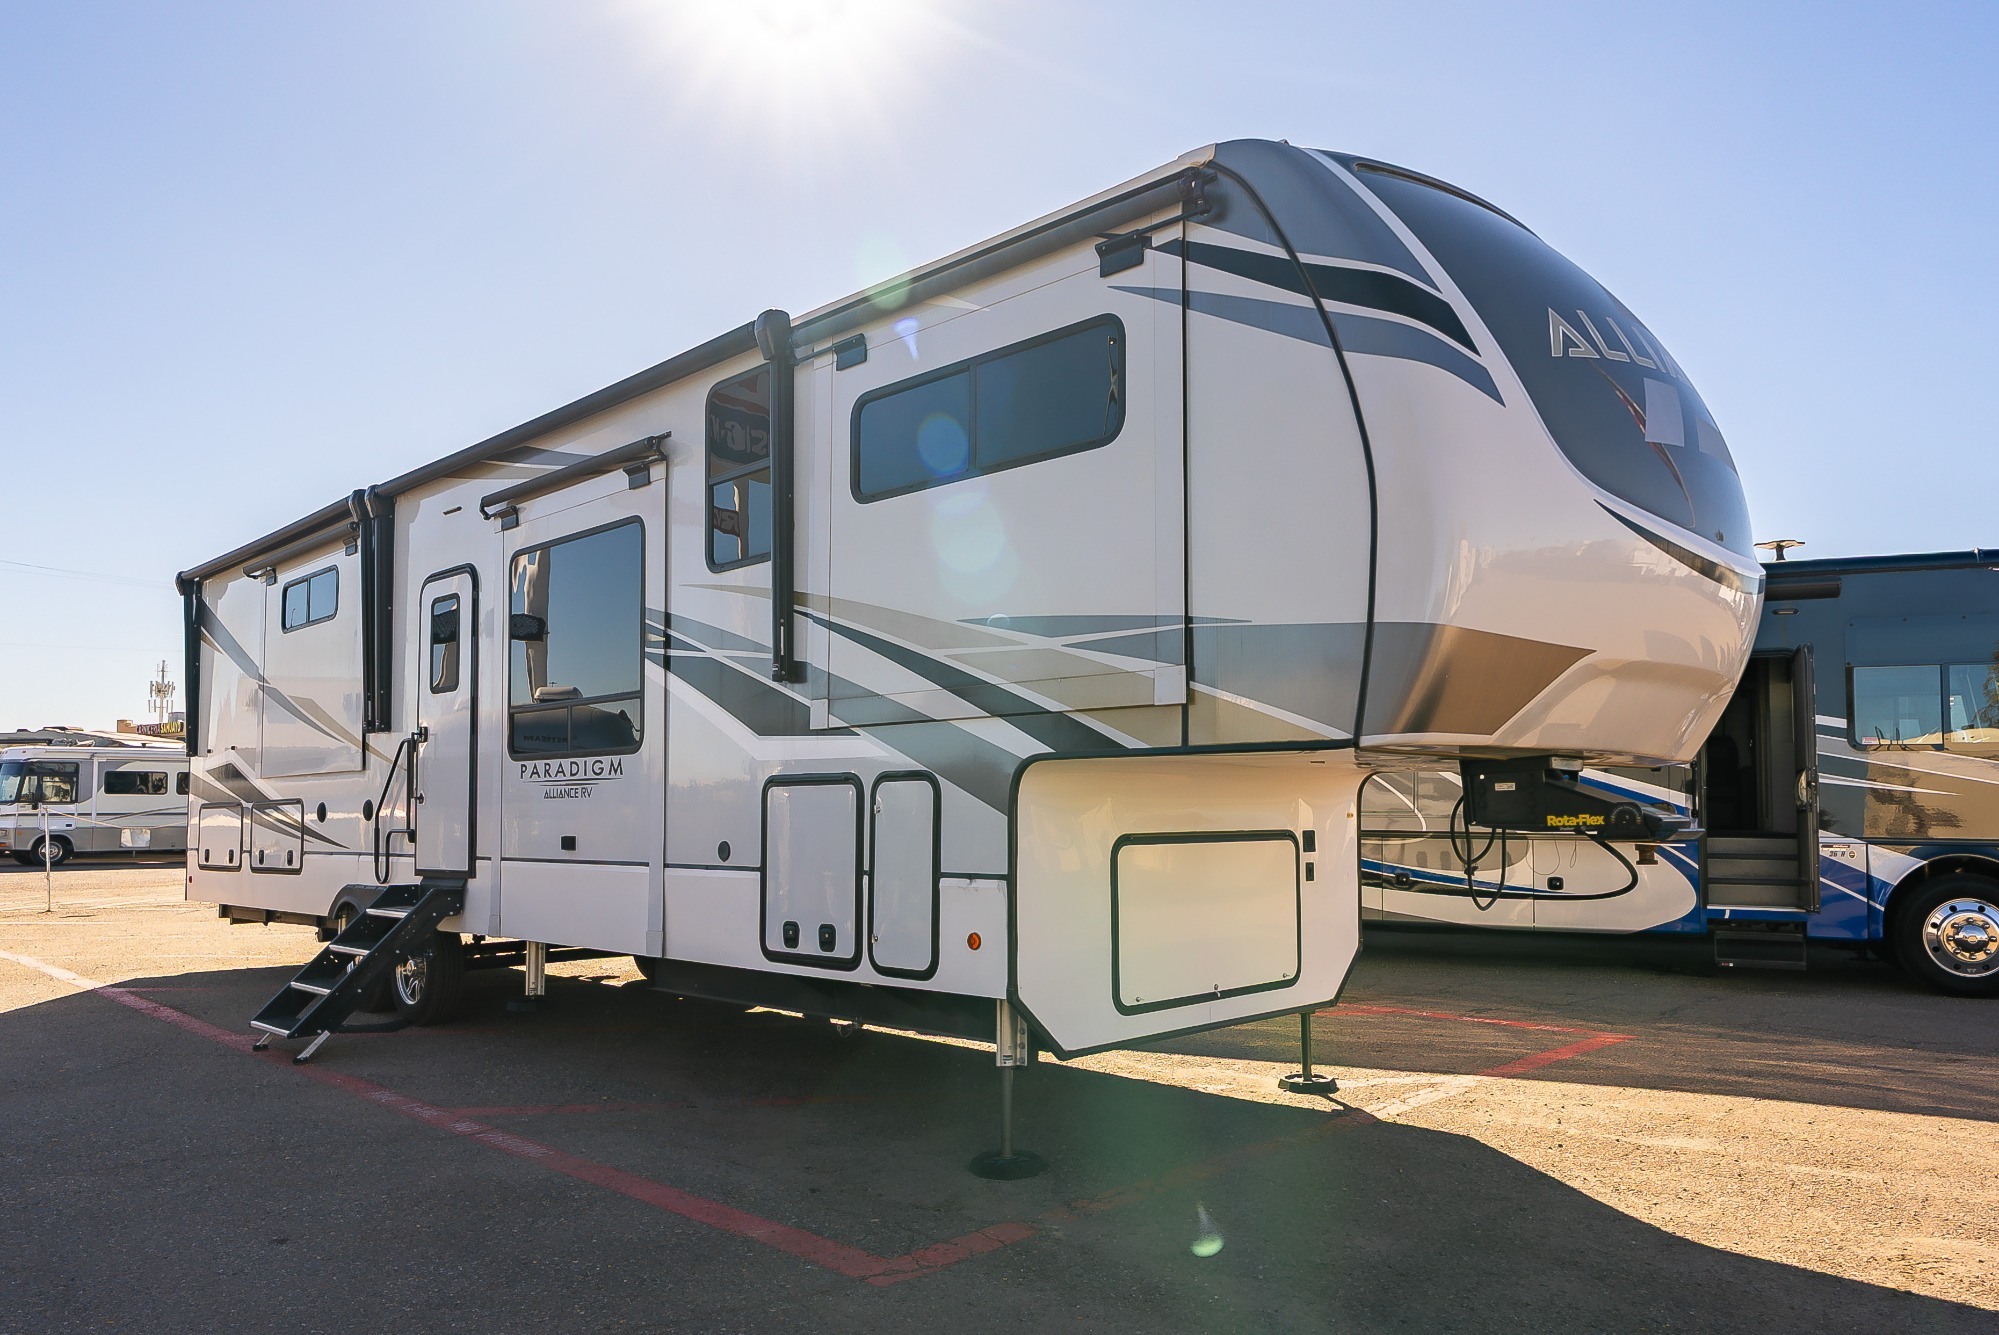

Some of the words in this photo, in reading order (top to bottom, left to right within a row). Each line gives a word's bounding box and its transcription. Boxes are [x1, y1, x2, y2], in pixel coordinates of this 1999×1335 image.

[520, 757, 624, 779] PARADIGM
[543, 787, 579, 799] ALLIANCE
[580, 787, 593, 799] RV
[1546, 814, 1605, 826] Rota-Flex
